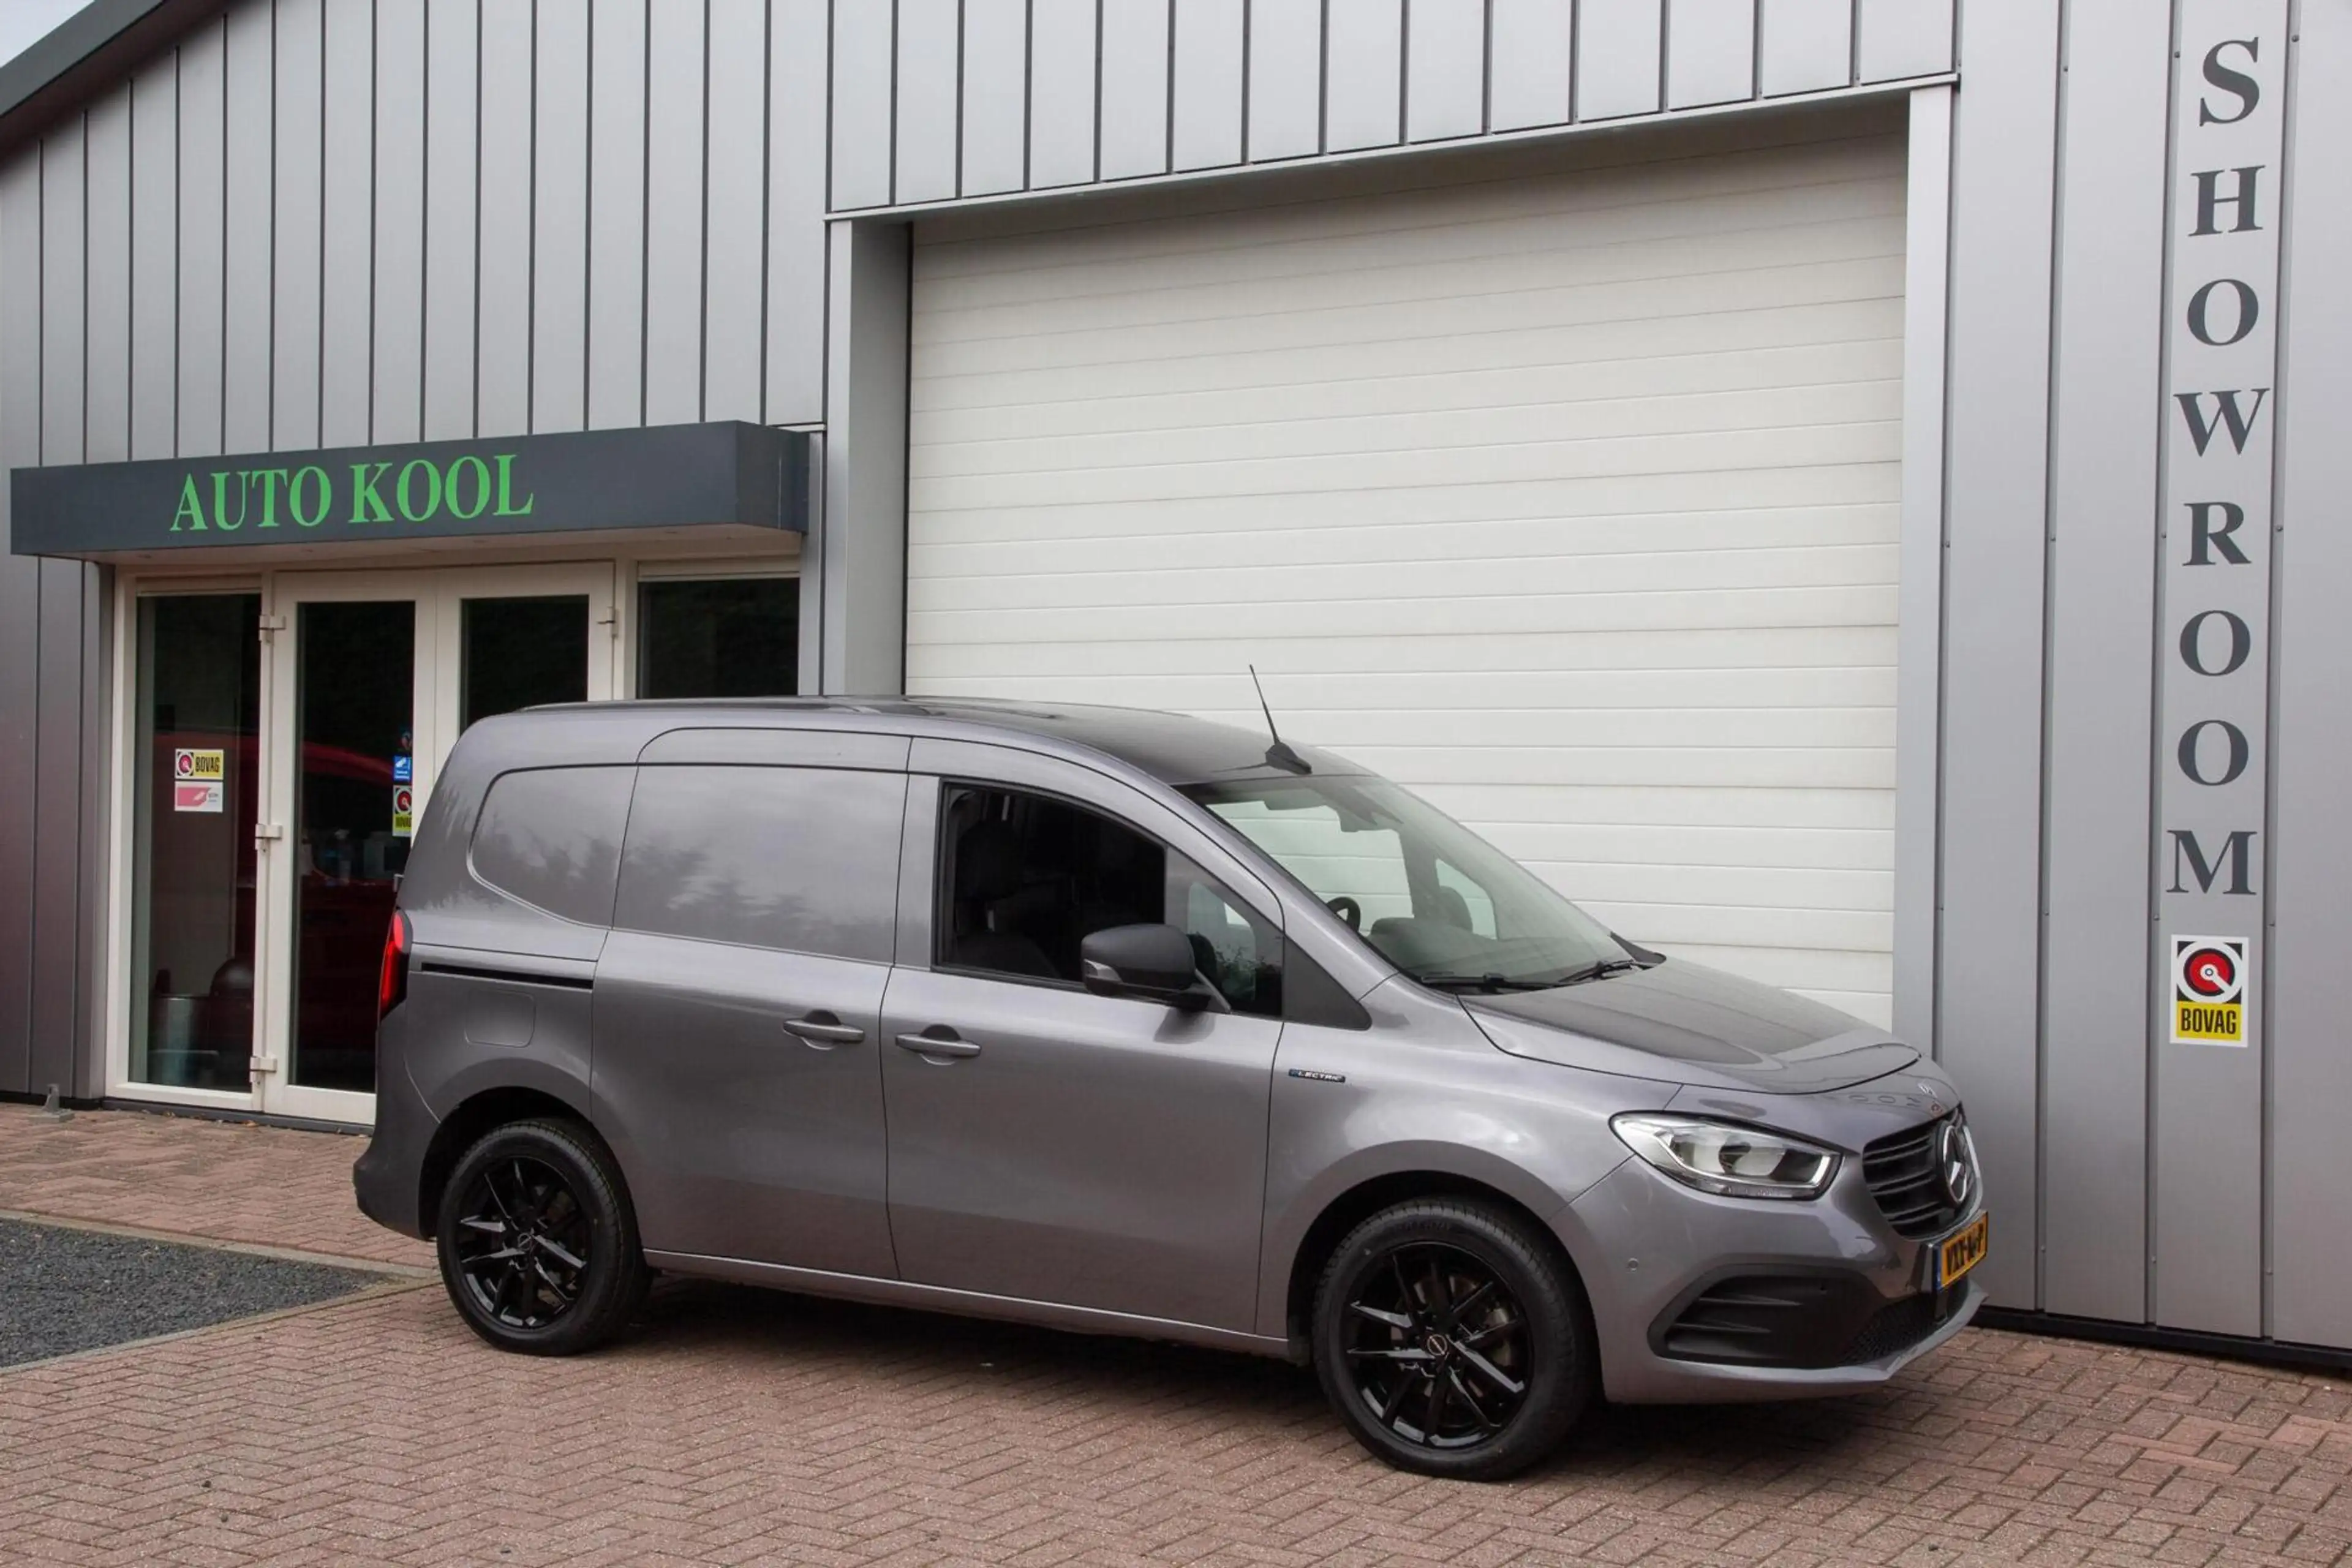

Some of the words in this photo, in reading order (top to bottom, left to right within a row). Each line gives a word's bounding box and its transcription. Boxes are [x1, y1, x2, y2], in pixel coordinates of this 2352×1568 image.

[2165, 37, 2270, 895] SHOWROOM
[170, 466, 331, 532] AUTO
[349, 454, 534, 524] KOOL
[195, 756, 219, 773] BOVAG
[2180, 1008, 2237, 1035] BOVAG
